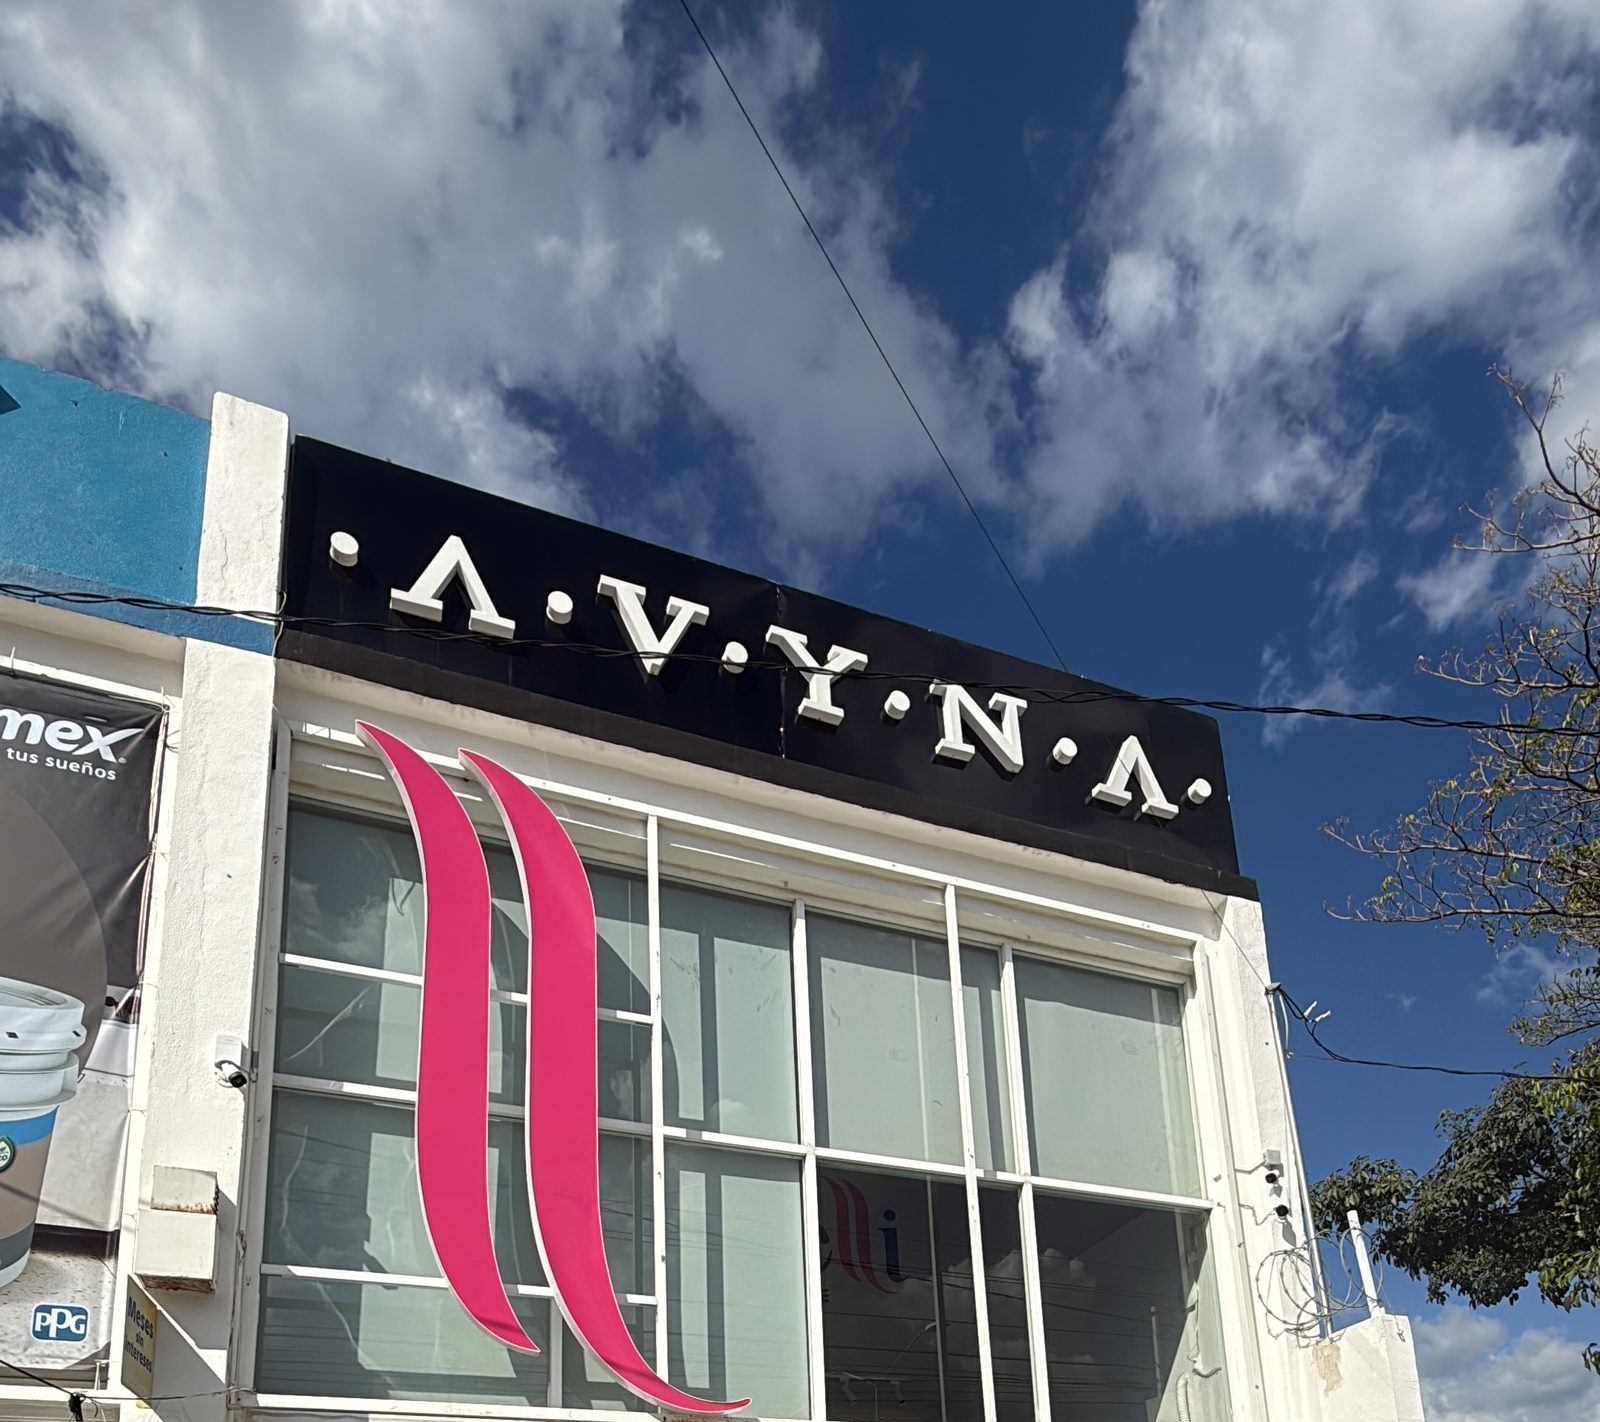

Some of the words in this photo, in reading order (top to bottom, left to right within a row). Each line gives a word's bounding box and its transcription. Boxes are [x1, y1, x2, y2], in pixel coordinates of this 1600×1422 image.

[6, 747, 39, 764] tus
[45, 756, 117, 781] sueños
[34, 1308, 86, 1338] PPG
[127, 1296, 154, 1339] Meses
